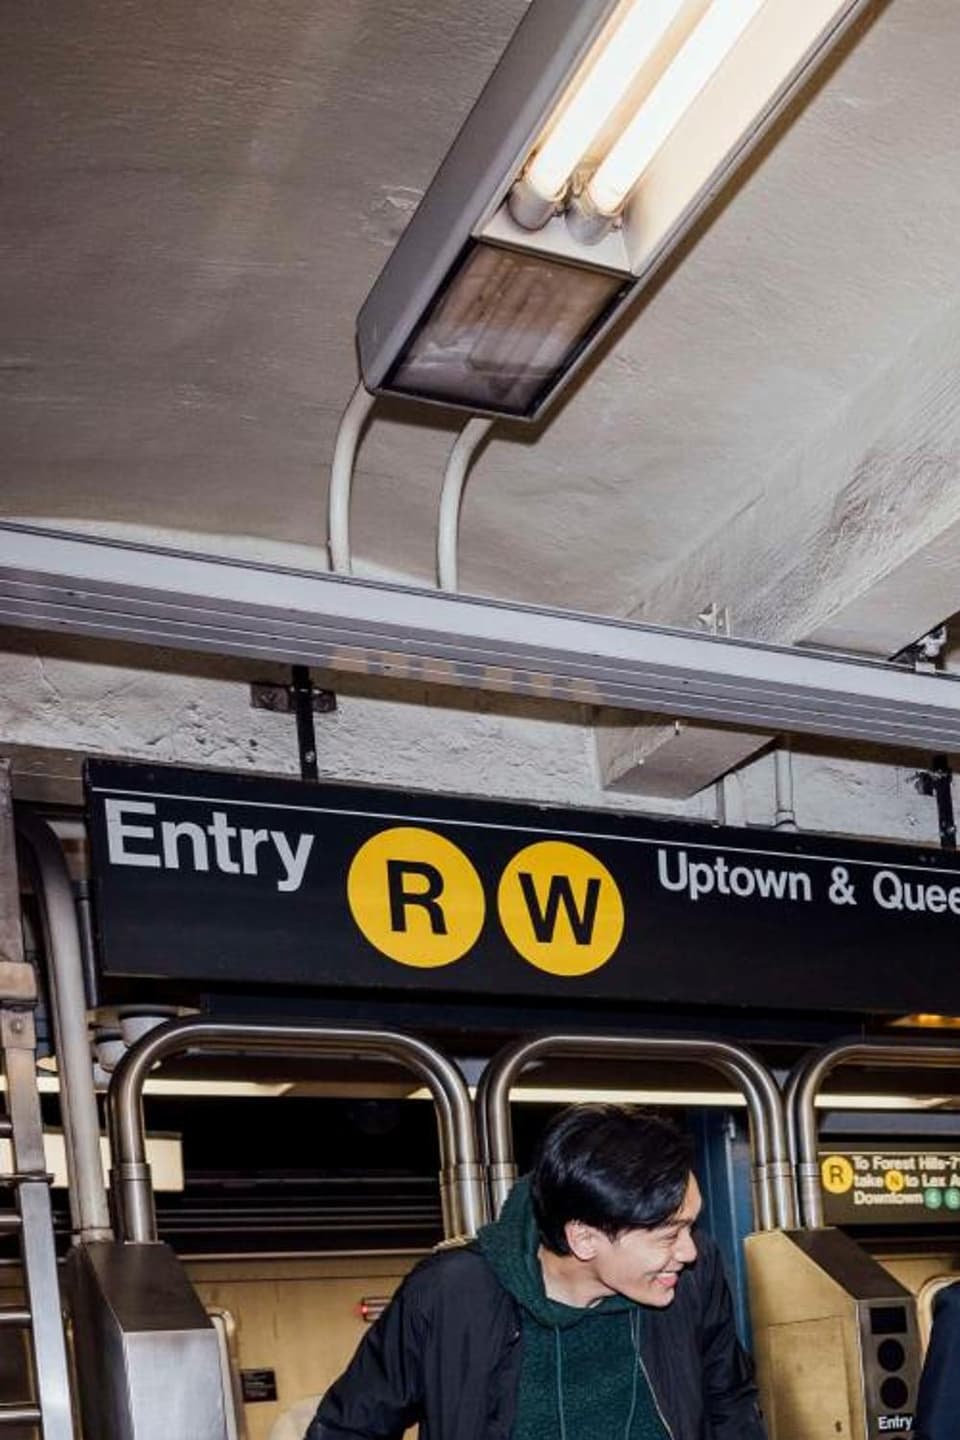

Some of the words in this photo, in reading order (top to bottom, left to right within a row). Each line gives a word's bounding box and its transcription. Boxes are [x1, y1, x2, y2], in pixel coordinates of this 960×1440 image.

[104, 798, 314, 892] Entry
[386, 859, 449, 936] R
[517, 871, 601, 946] W
[657, 849, 812, 900] Uptown
[828, 866, 857, 905] &
[852, 1155, 870, 1170] To
[830, 1164, 844, 1184] R
[904, 1174, 920, 1188] to
[854, 1190, 923, 1205] Downtown
[877, 1415, 913, 1431] Entry
